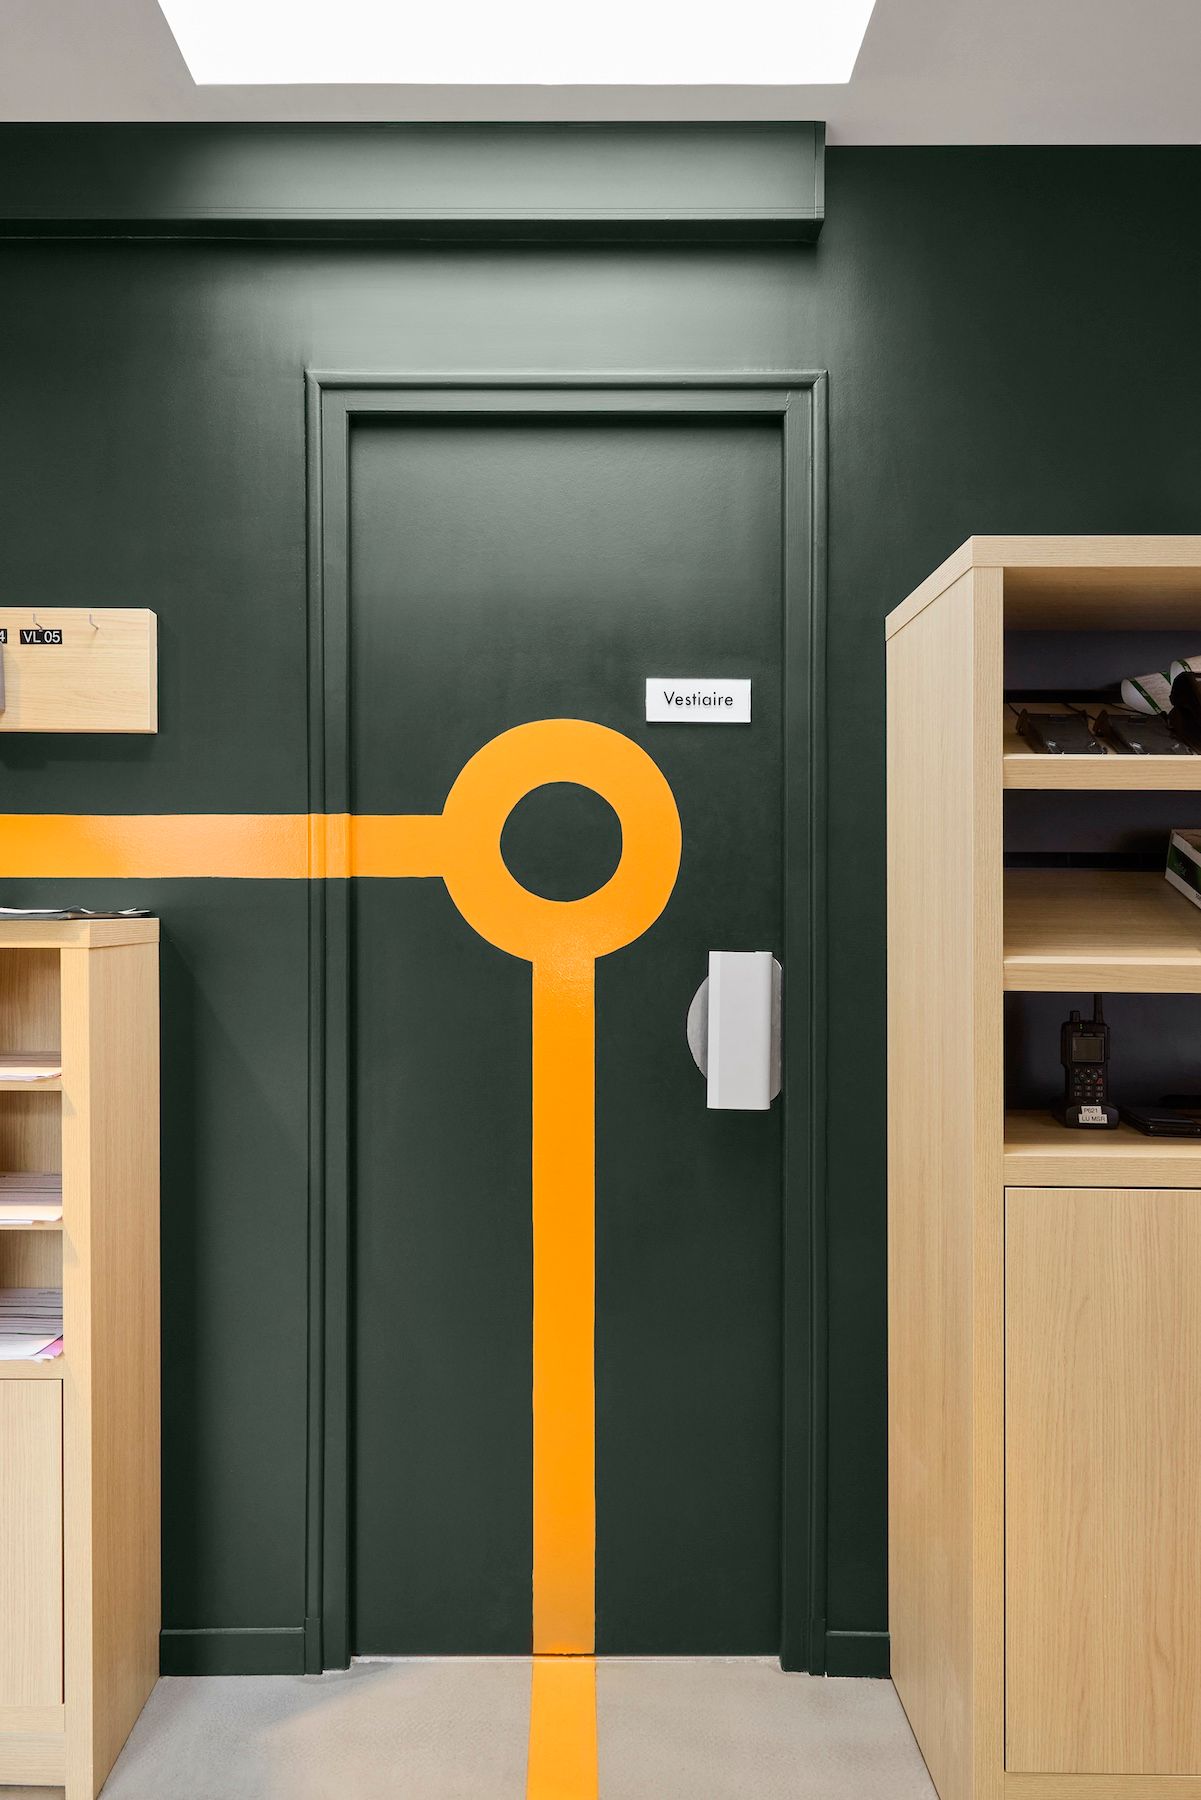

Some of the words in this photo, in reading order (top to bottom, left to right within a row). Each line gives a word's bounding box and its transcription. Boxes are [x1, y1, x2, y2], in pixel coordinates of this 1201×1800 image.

[23, 631, 42, 643] VL
[44, 631, 61, 643] 05
[663, 691, 734, 706] Vestiaire
